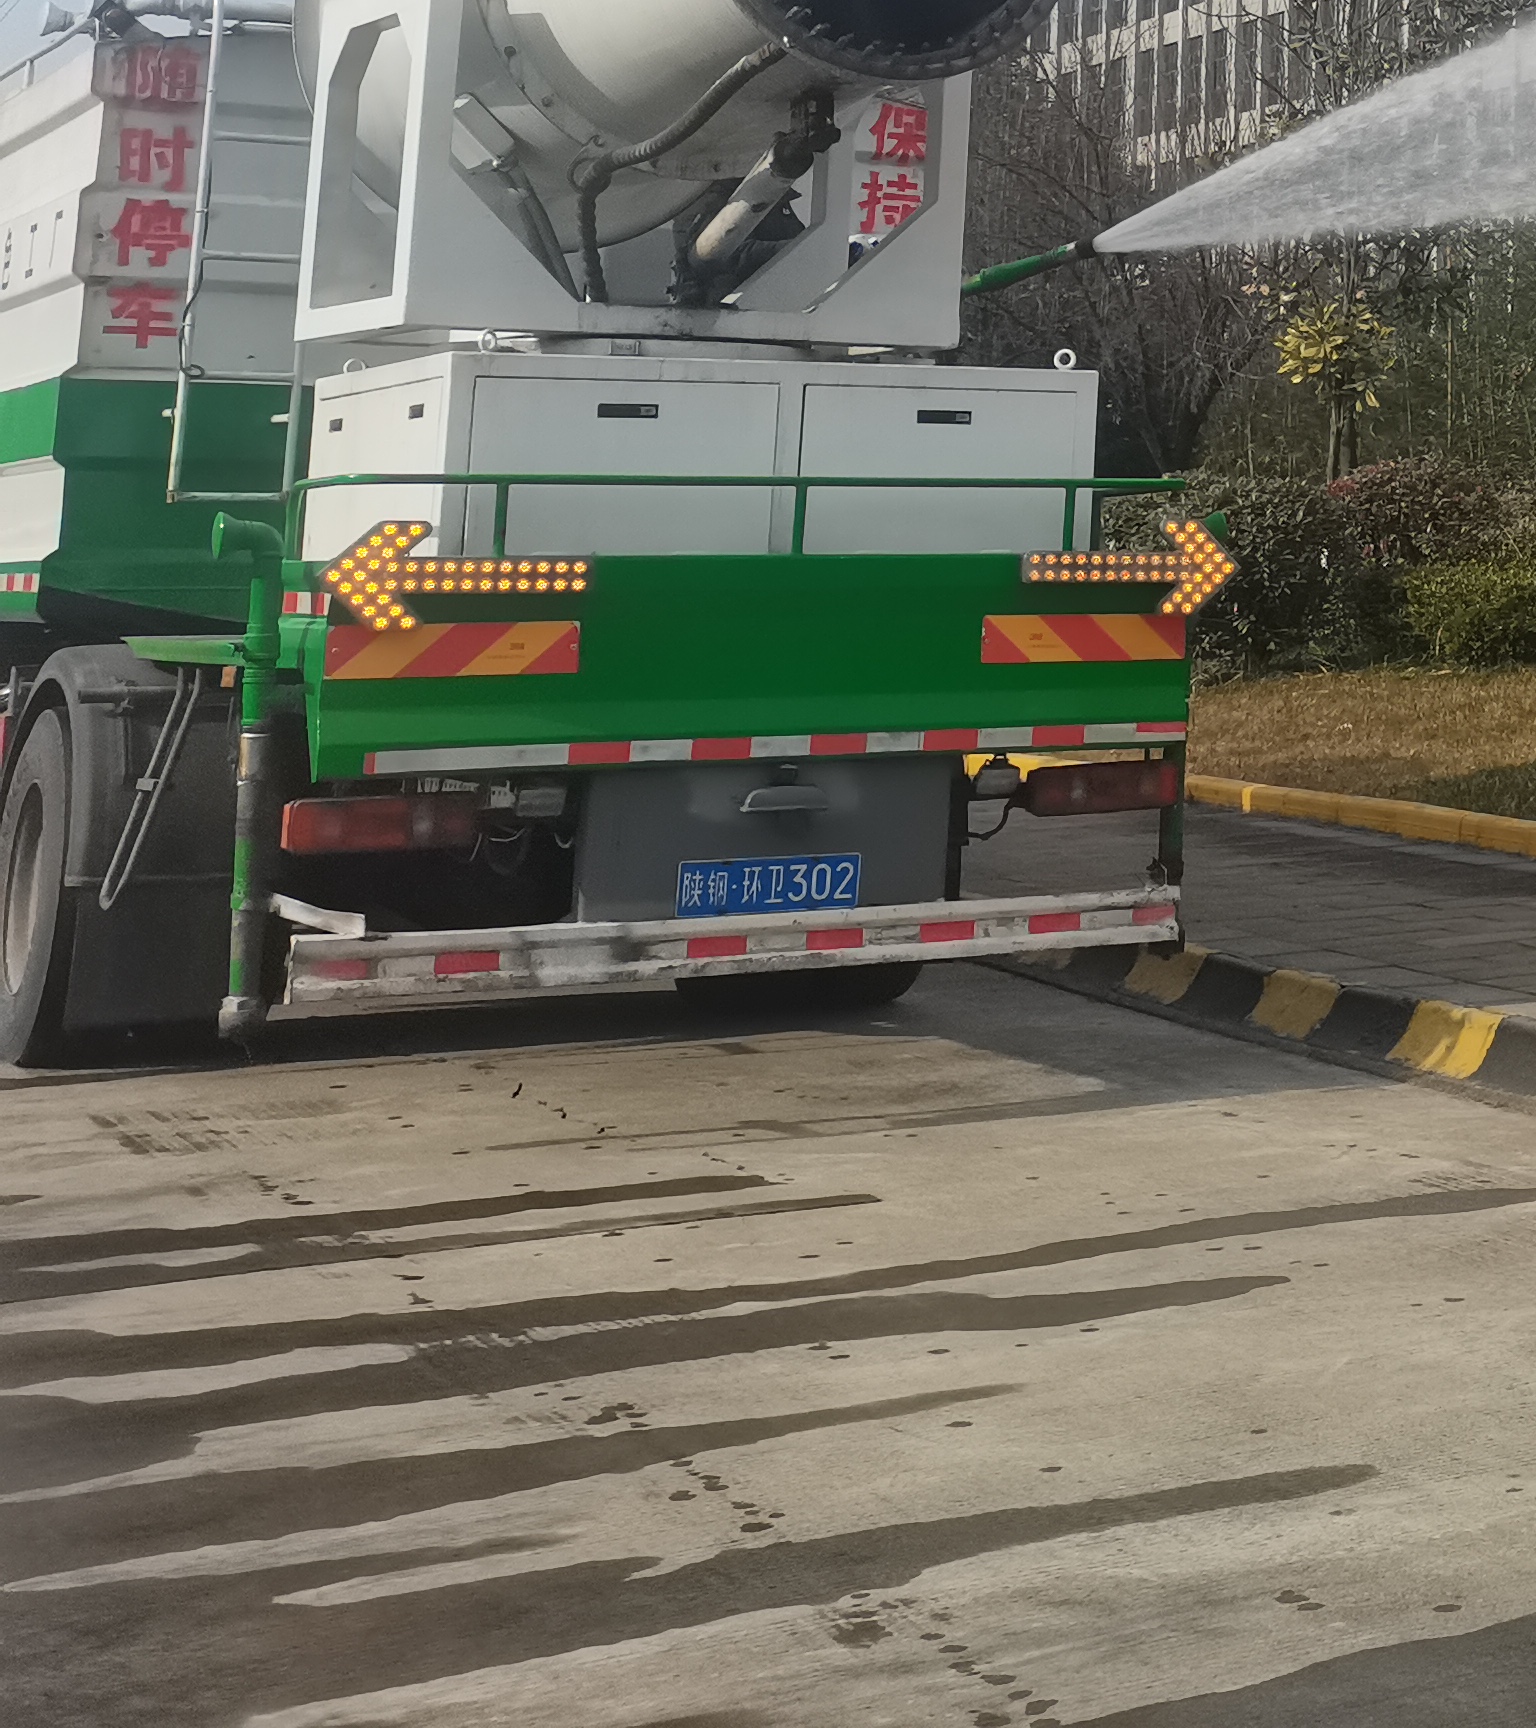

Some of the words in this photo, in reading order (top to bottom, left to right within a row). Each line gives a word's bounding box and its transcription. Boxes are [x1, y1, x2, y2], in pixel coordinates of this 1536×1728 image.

[103, 44, 201, 349] 随时停车
[857, 102, 928, 235] 保持
